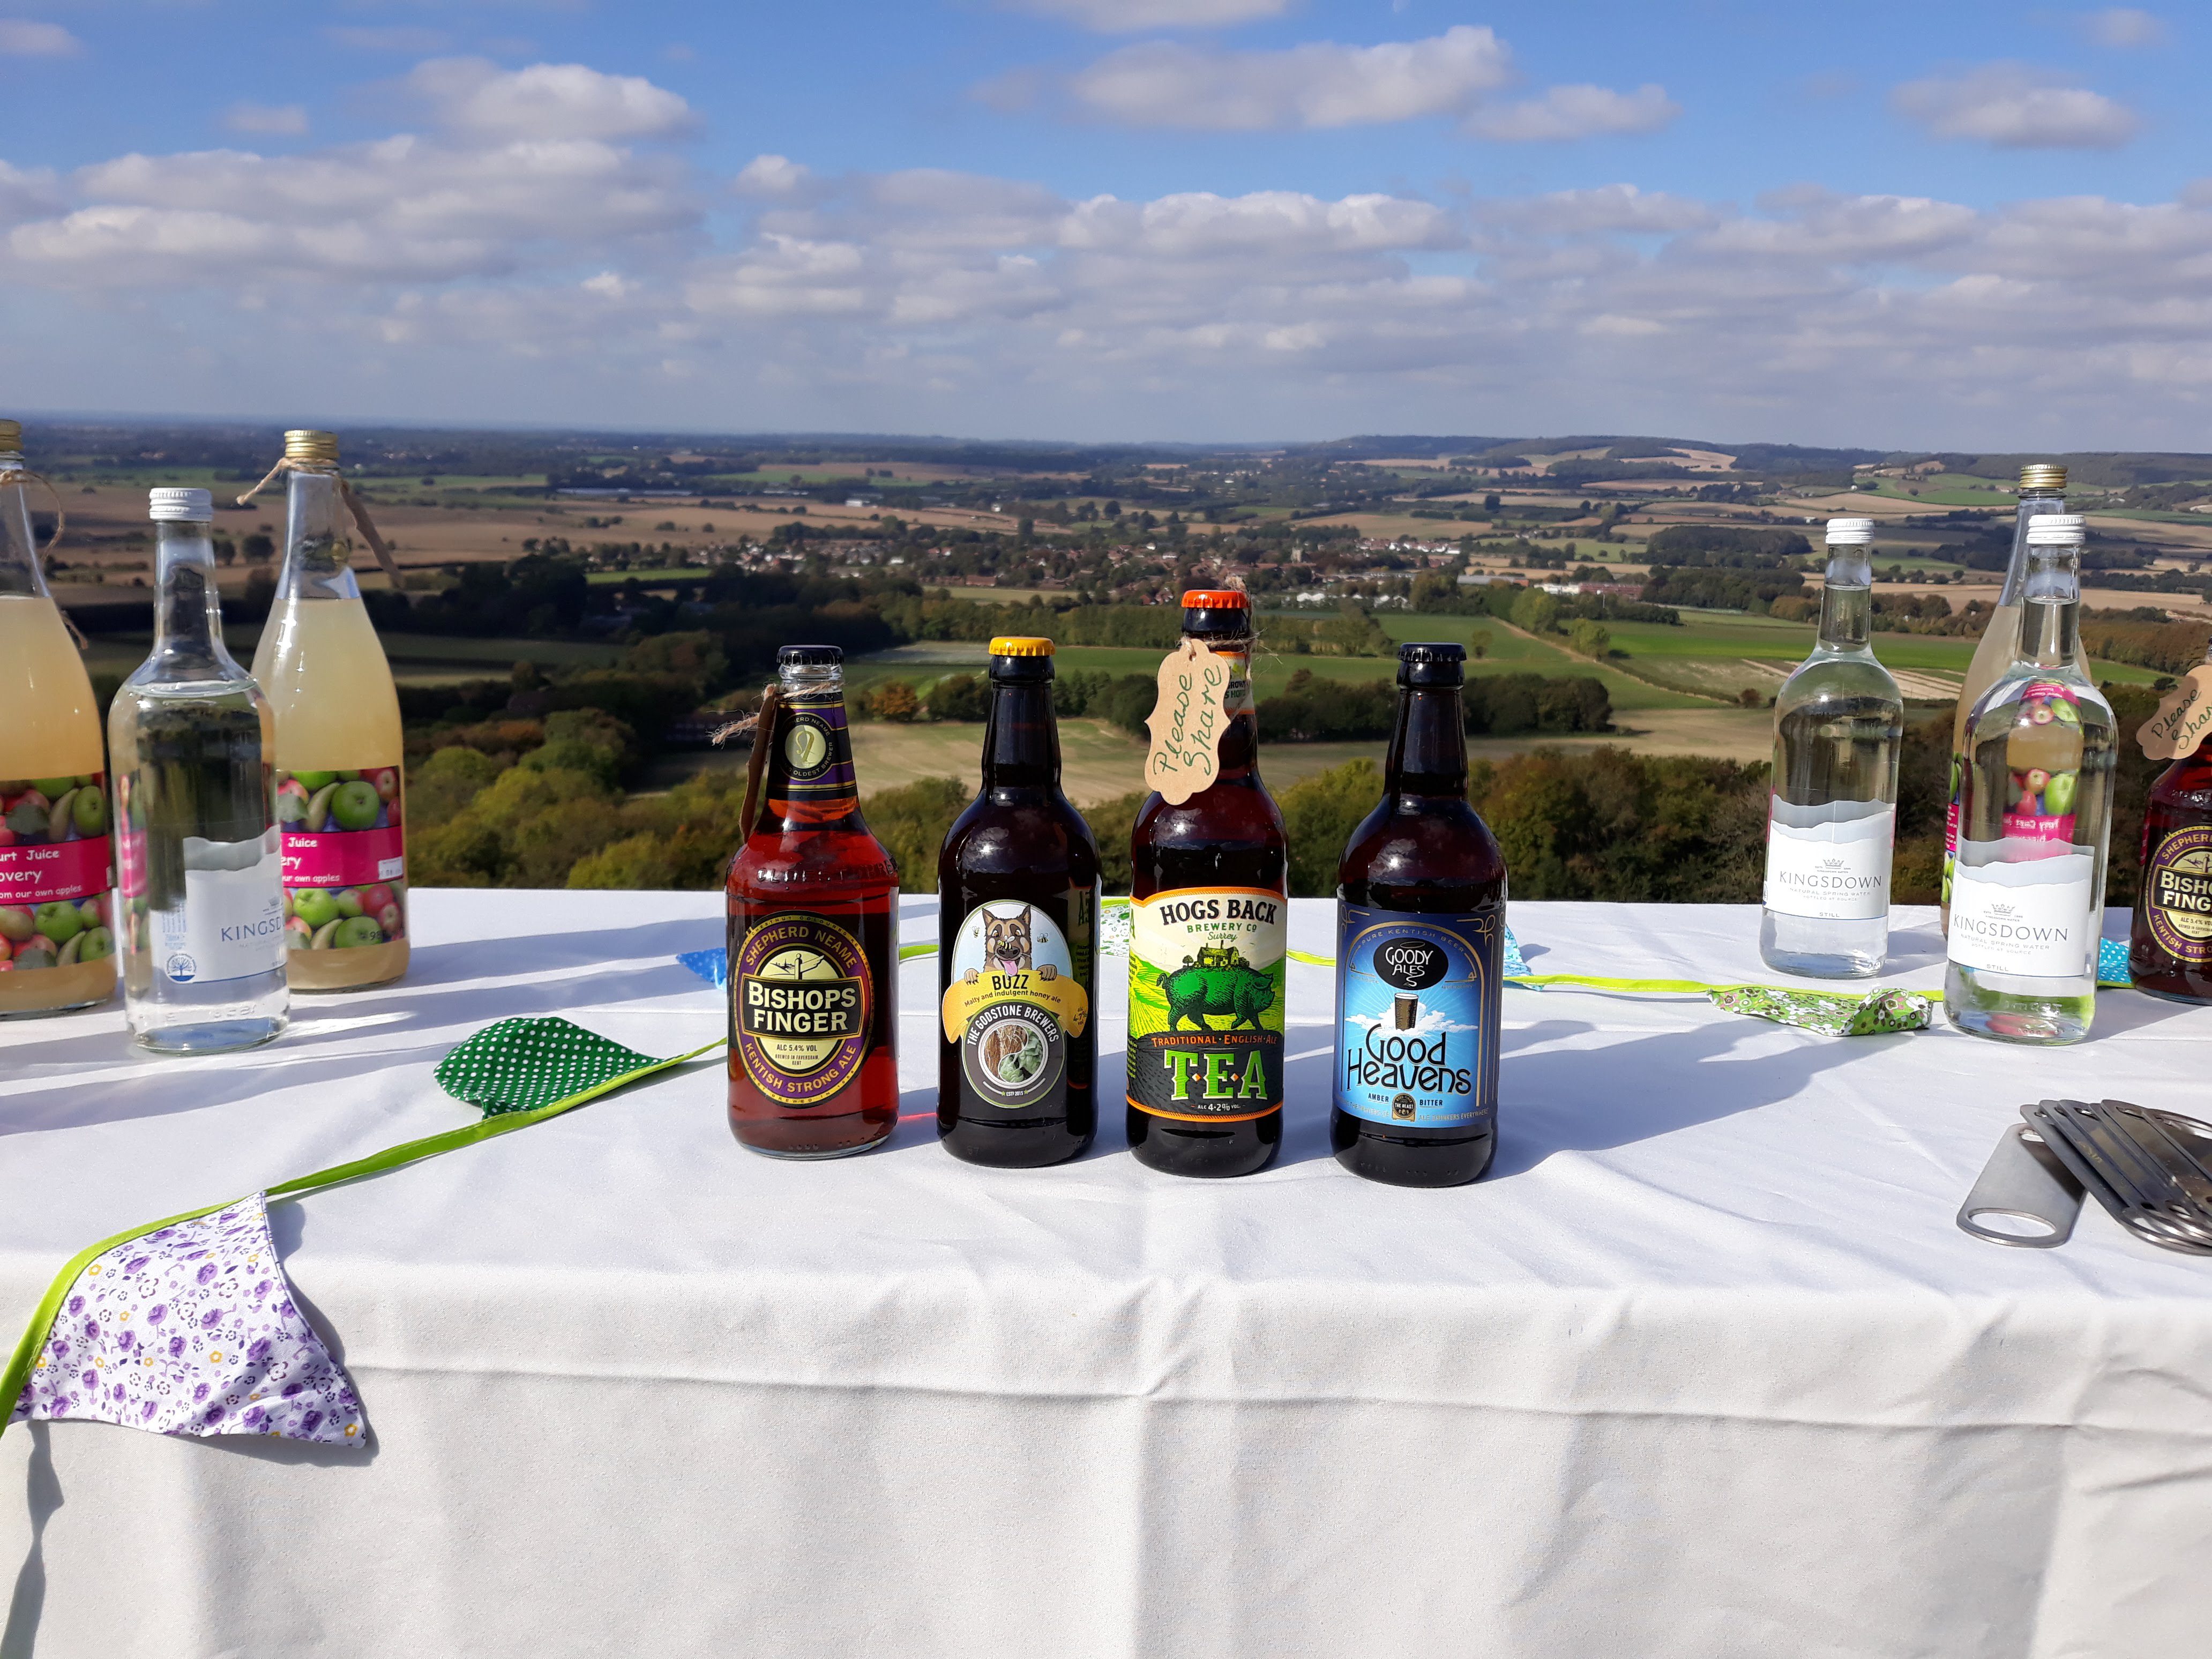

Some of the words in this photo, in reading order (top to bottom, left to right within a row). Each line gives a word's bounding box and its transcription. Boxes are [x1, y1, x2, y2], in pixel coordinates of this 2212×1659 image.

[1153, 673, 1192, 775] Please
[1184, 665, 1221, 776] Share
[2151, 689, 2202, 739] Please
[793, 767, 820, 776] OLDEST
[288, 836, 318, 848] Juice
[2162, 834, 2212, 860] SHEPHER
[26, 848, 60, 861] Juice
[16, 890, 32, 898] our
[35, 889, 54, 897] own
[55, 885, 82, 896] apples
[313, 875, 340, 884] apples
[1780, 871, 1882, 889] KINGSDOWN
[2160, 870, 2212, 895] BISH
[1160, 900, 1220, 926] HOGS
[1227, 899, 1277, 925] BACK
[221, 916, 285, 942] KINGSD
[1187, 923, 1243, 933] BREWERY
[1207, 932, 1238, 942] Surrey
[1954, 914, 2068, 941] KINGSDOWN
[2153, 914, 2183, 950] KENTISH
[746, 926, 810, 966] SHEPHERD
[814, 929, 858, 969] NEAME
[1362, 931, 1383, 945] PURE
[1388, 929, 1436, 938] KENTISH
[1440, 936, 1464, 952] BEER
[1961, 933, 1987, 944] NATURAL
[1991, 940, 2020, 948] SPRING
[1386, 946, 1433, 965] GOODY
[992, 974, 1029, 990] BUZZ
[1392, 964, 1425, 981] ALES
[749, 981, 856, 1010] BISHOPS
[965, 995, 980, 1007] Malty
[981, 992, 993, 1000] and
[1030, 990, 1050, 1000] honey
[753, 1009, 848, 1033] FINGER
[967, 1028, 980, 1045] THE
[975, 1005, 1022, 1029] GODSTONE
[1024, 1006, 1059, 1043] BREWERS
[1366, 1023, 1446, 1066] Good
[745, 1042, 784, 1089] KENTISH
[787, 1068, 839, 1093] STRONG
[838, 1044, 857, 1070] ALE
[1347, 1048, 1471, 1095] Heavens
[1368, 1093, 1389, 1103] AMBER
